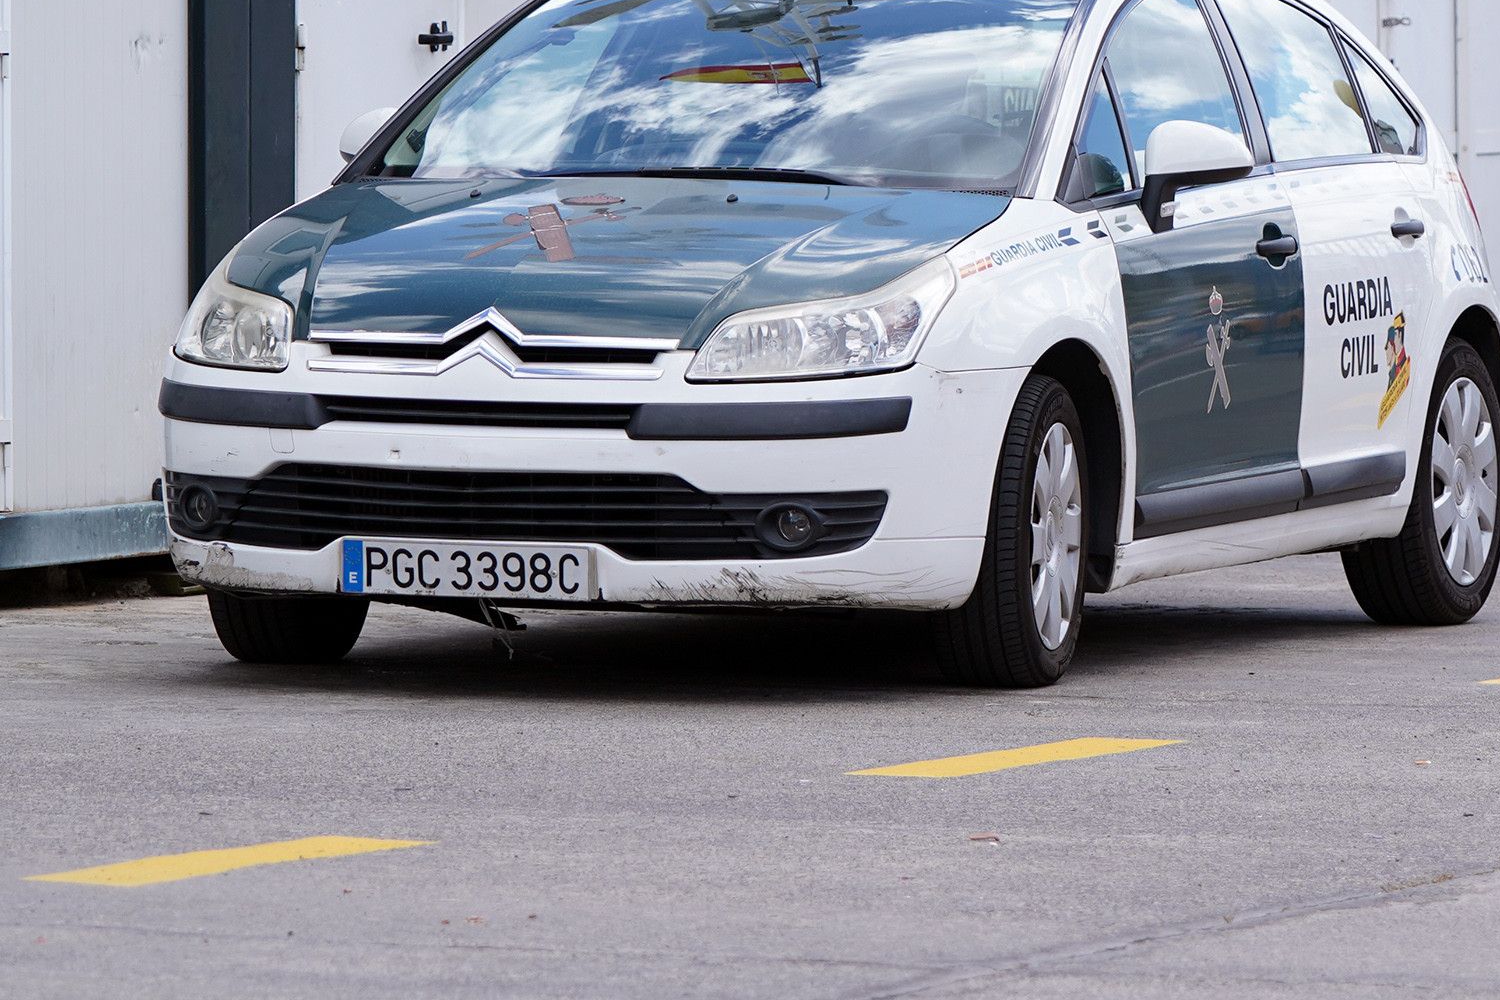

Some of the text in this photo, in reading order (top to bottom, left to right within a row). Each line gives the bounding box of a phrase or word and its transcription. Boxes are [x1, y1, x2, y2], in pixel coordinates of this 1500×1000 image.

[990, 232, 1063, 266] GUARDIA CIVIL
[1323, 276, 1393, 326] GUARDIA
[1340, 334, 1379, 379] CIVIL
[349, 546, 580, 595] E PGC 3398C
